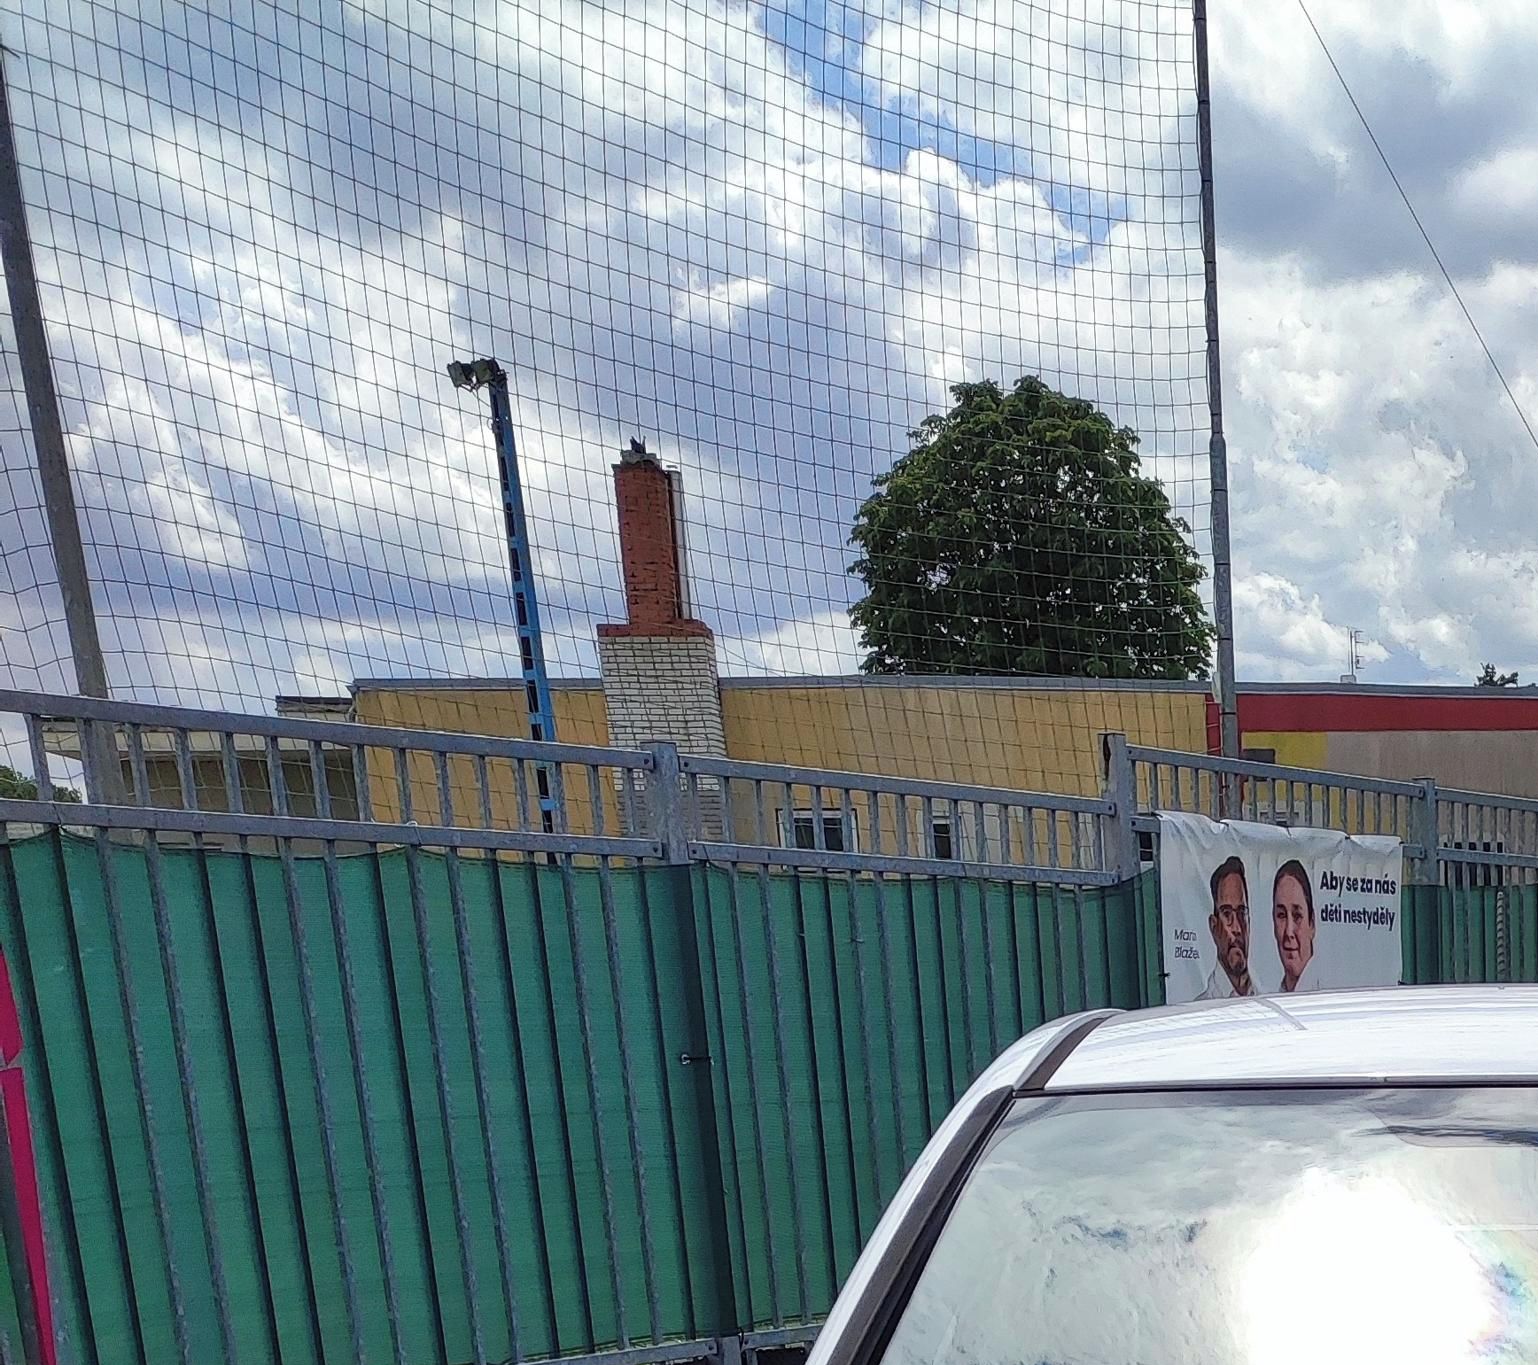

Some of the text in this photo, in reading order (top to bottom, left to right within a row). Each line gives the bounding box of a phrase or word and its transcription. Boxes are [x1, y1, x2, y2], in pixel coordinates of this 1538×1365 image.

[1320, 871, 1396, 897] Aby se za nás
[1321, 903, 1395, 931] děti nestyděly
